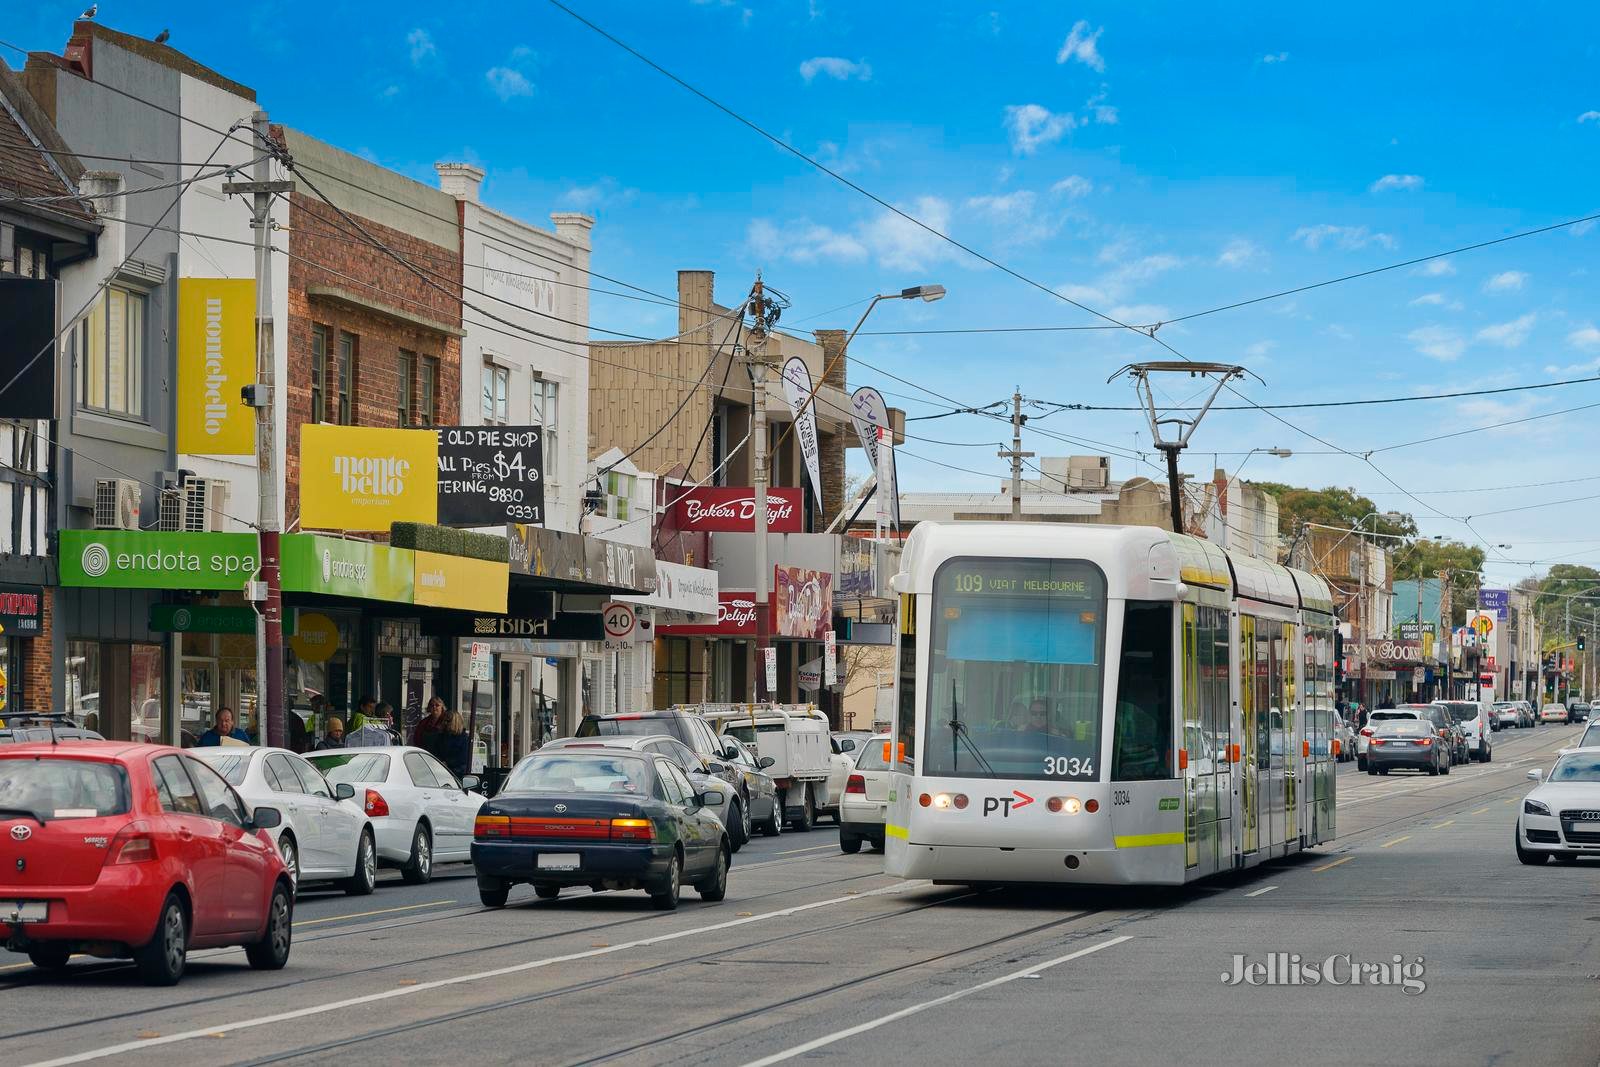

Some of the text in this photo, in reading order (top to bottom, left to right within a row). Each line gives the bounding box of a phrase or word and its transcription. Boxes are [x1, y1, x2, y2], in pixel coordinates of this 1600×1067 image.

[205, 298, 228, 435] montebello
[448, 430, 475, 446] OLD
[477, 430, 500, 447] PIE
[502, 431, 539, 448] SHOP
[332, 455, 410, 478] monte
[460, 457, 491, 473] Pies
[341, 474, 404, 497] bello
[471, 473, 495, 481] FROM
[488, 486, 524, 503] 9830
[506, 504, 540, 520] 0331
[686, 499, 792, 525] Bakers Dight
[116, 549, 257, 576] endota spa
[955, 574, 984, 593] 109
[1023, 579, 1086, 592] MELBOURNE
[1485, 592, 1499, 600] BUY
[608, 613, 630, 628] 40
[1043, 756, 1093, 777] 3034
[1113, 789, 1131, 806] 3034
